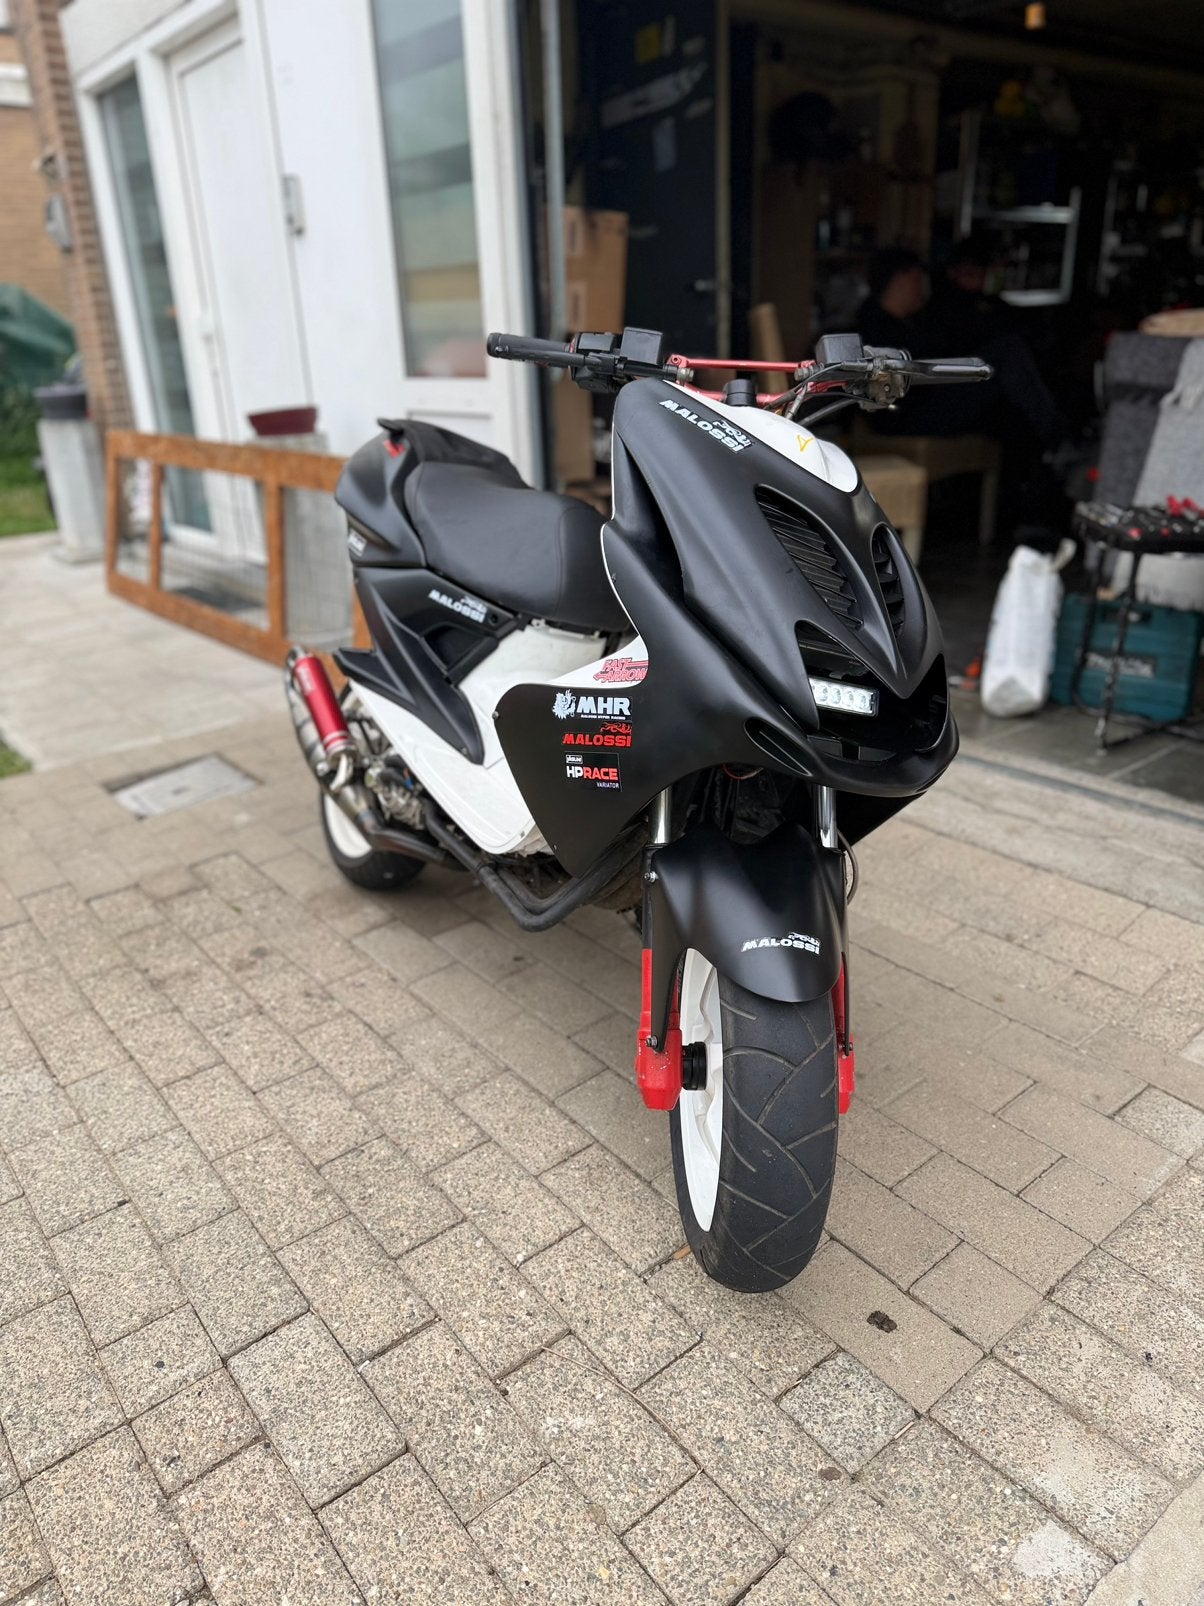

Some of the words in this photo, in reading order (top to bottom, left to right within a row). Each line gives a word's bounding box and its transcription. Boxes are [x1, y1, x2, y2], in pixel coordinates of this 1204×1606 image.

[659, 399, 744, 452] MALOSSI
[428, 589, 486, 623] MALOSSI
[602, 657, 632, 671] FAST
[600, 668, 648, 682] ARROW
[576, 696, 631, 715] MHR
[562, 733, 632, 747] MALOSSI
[741, 937, 820, 955] MALOSSI
